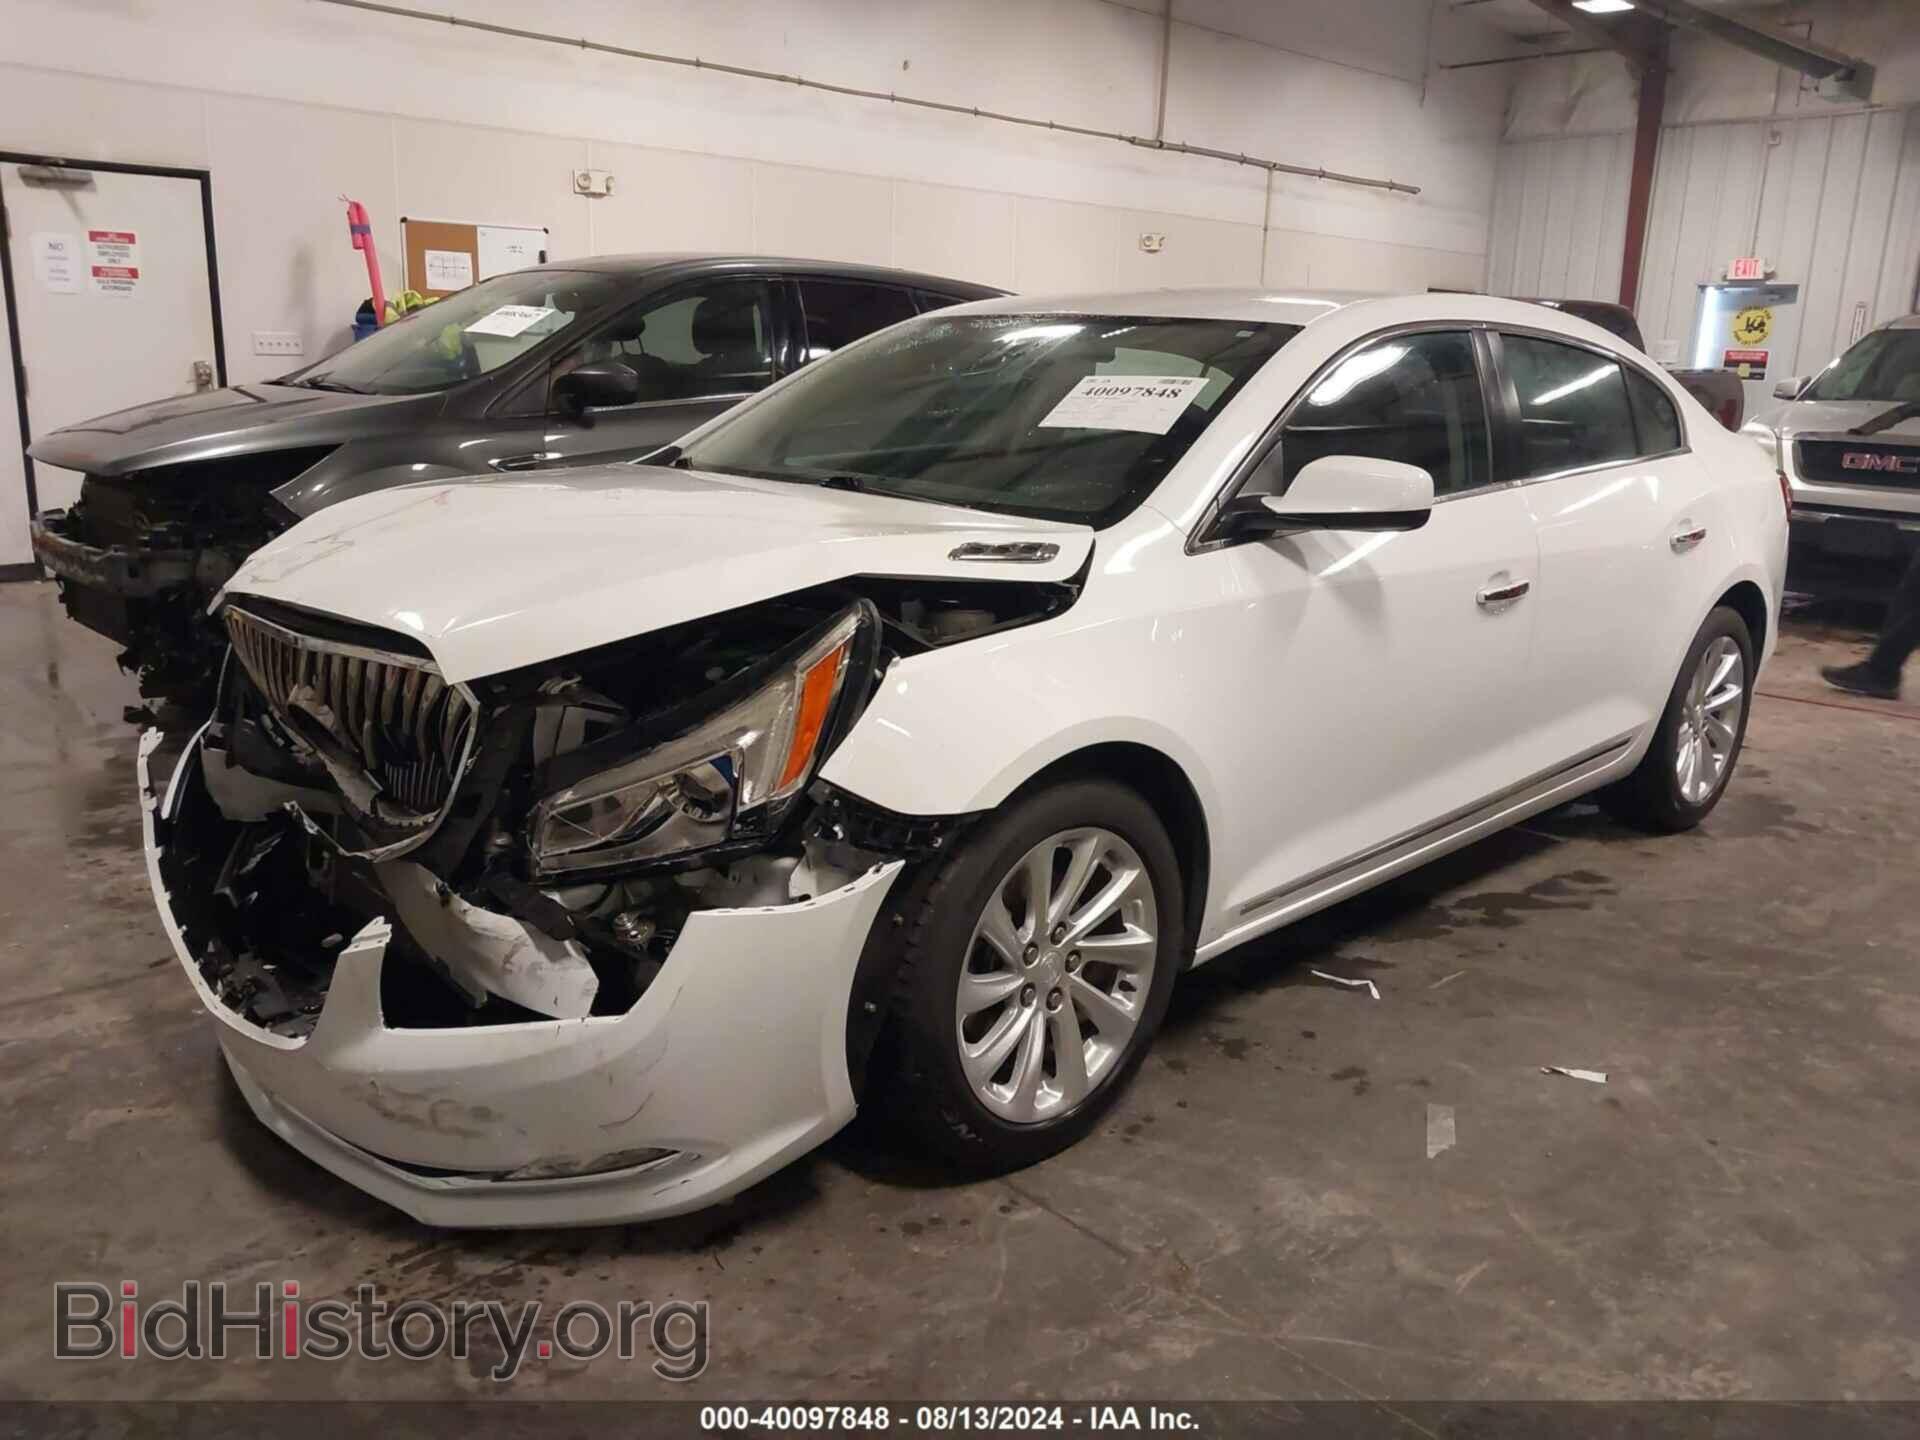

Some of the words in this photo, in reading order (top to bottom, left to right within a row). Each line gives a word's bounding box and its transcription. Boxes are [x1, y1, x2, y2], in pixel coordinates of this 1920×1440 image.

[1735, 259, 1759, 277] EXIT
[1081, 386, 1182, 399] 40097848
[1842, 452, 1918, 472] GMC
